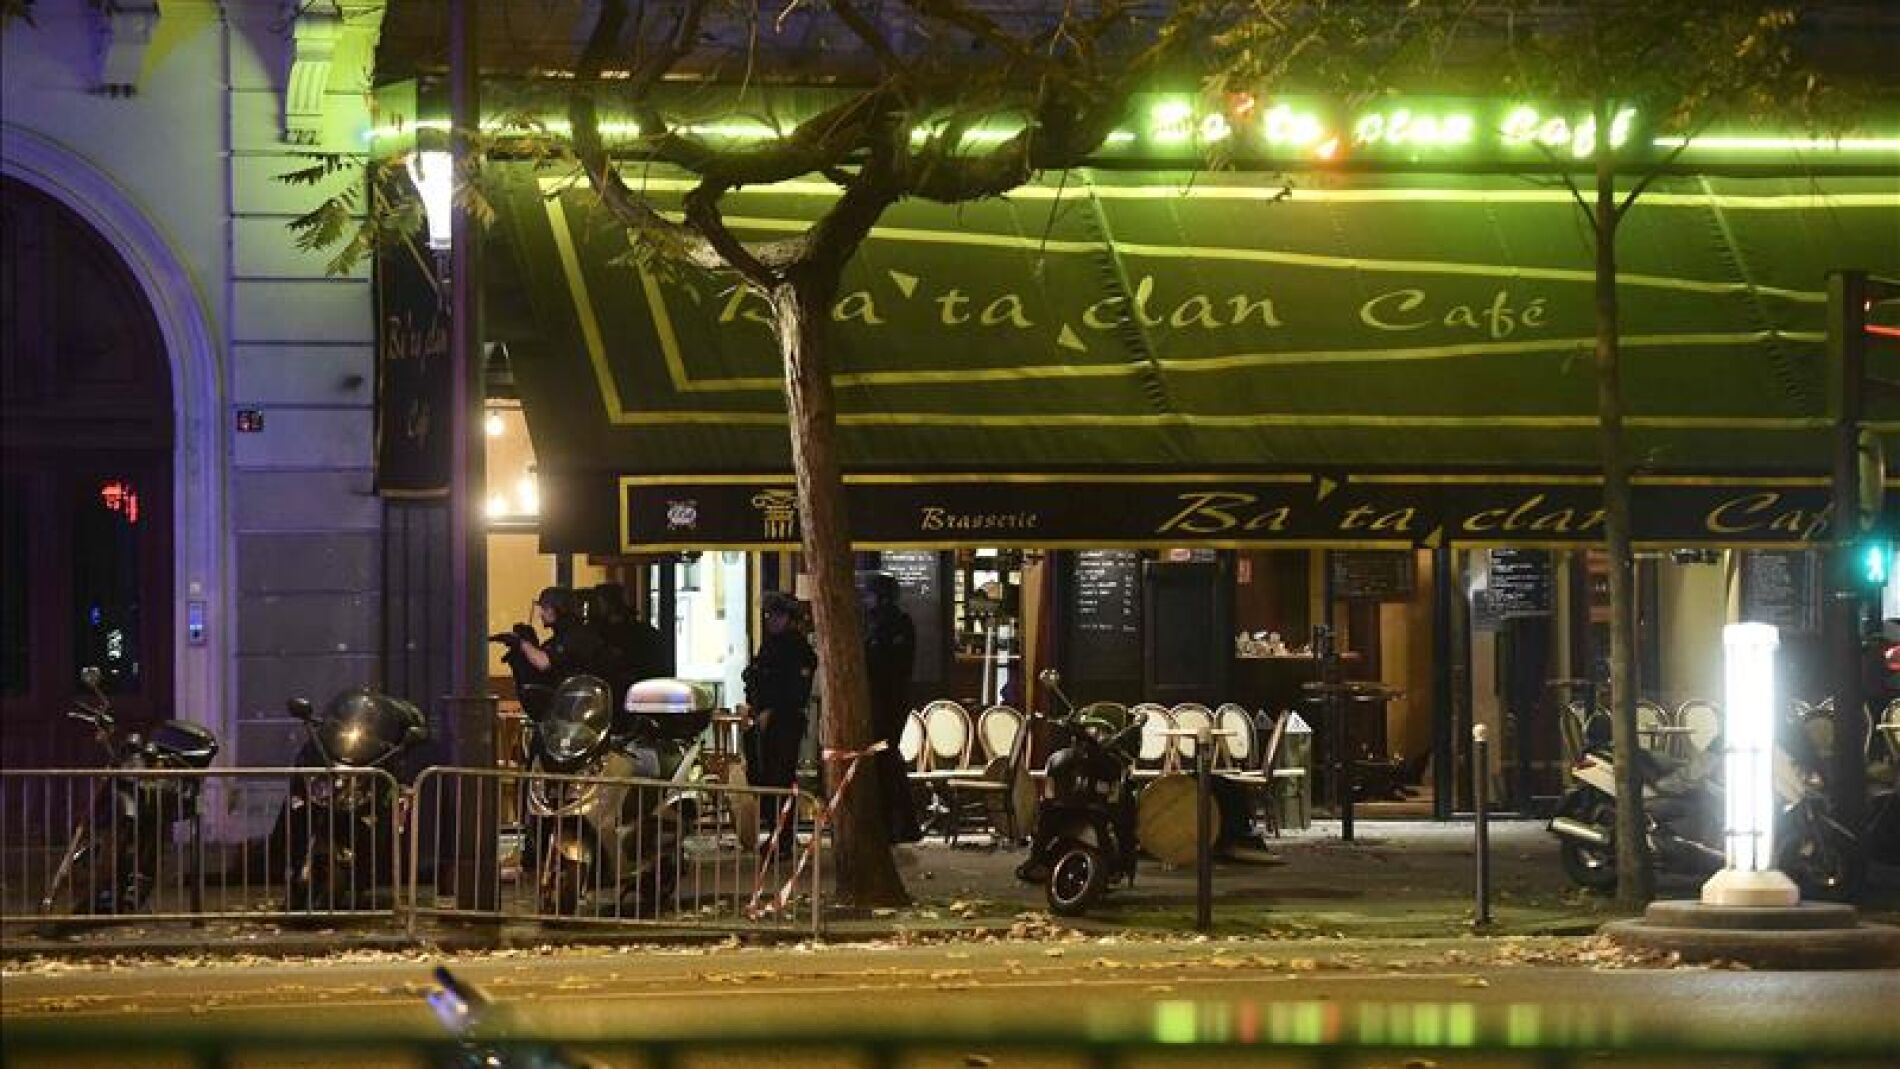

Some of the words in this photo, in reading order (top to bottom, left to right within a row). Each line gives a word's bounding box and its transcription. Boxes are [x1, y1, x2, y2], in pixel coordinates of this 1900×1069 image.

[1360, 289, 1547, 339] Café
[920, 507, 1039, 530] Brasserie
[1706, 492, 1836, 541] Caf
